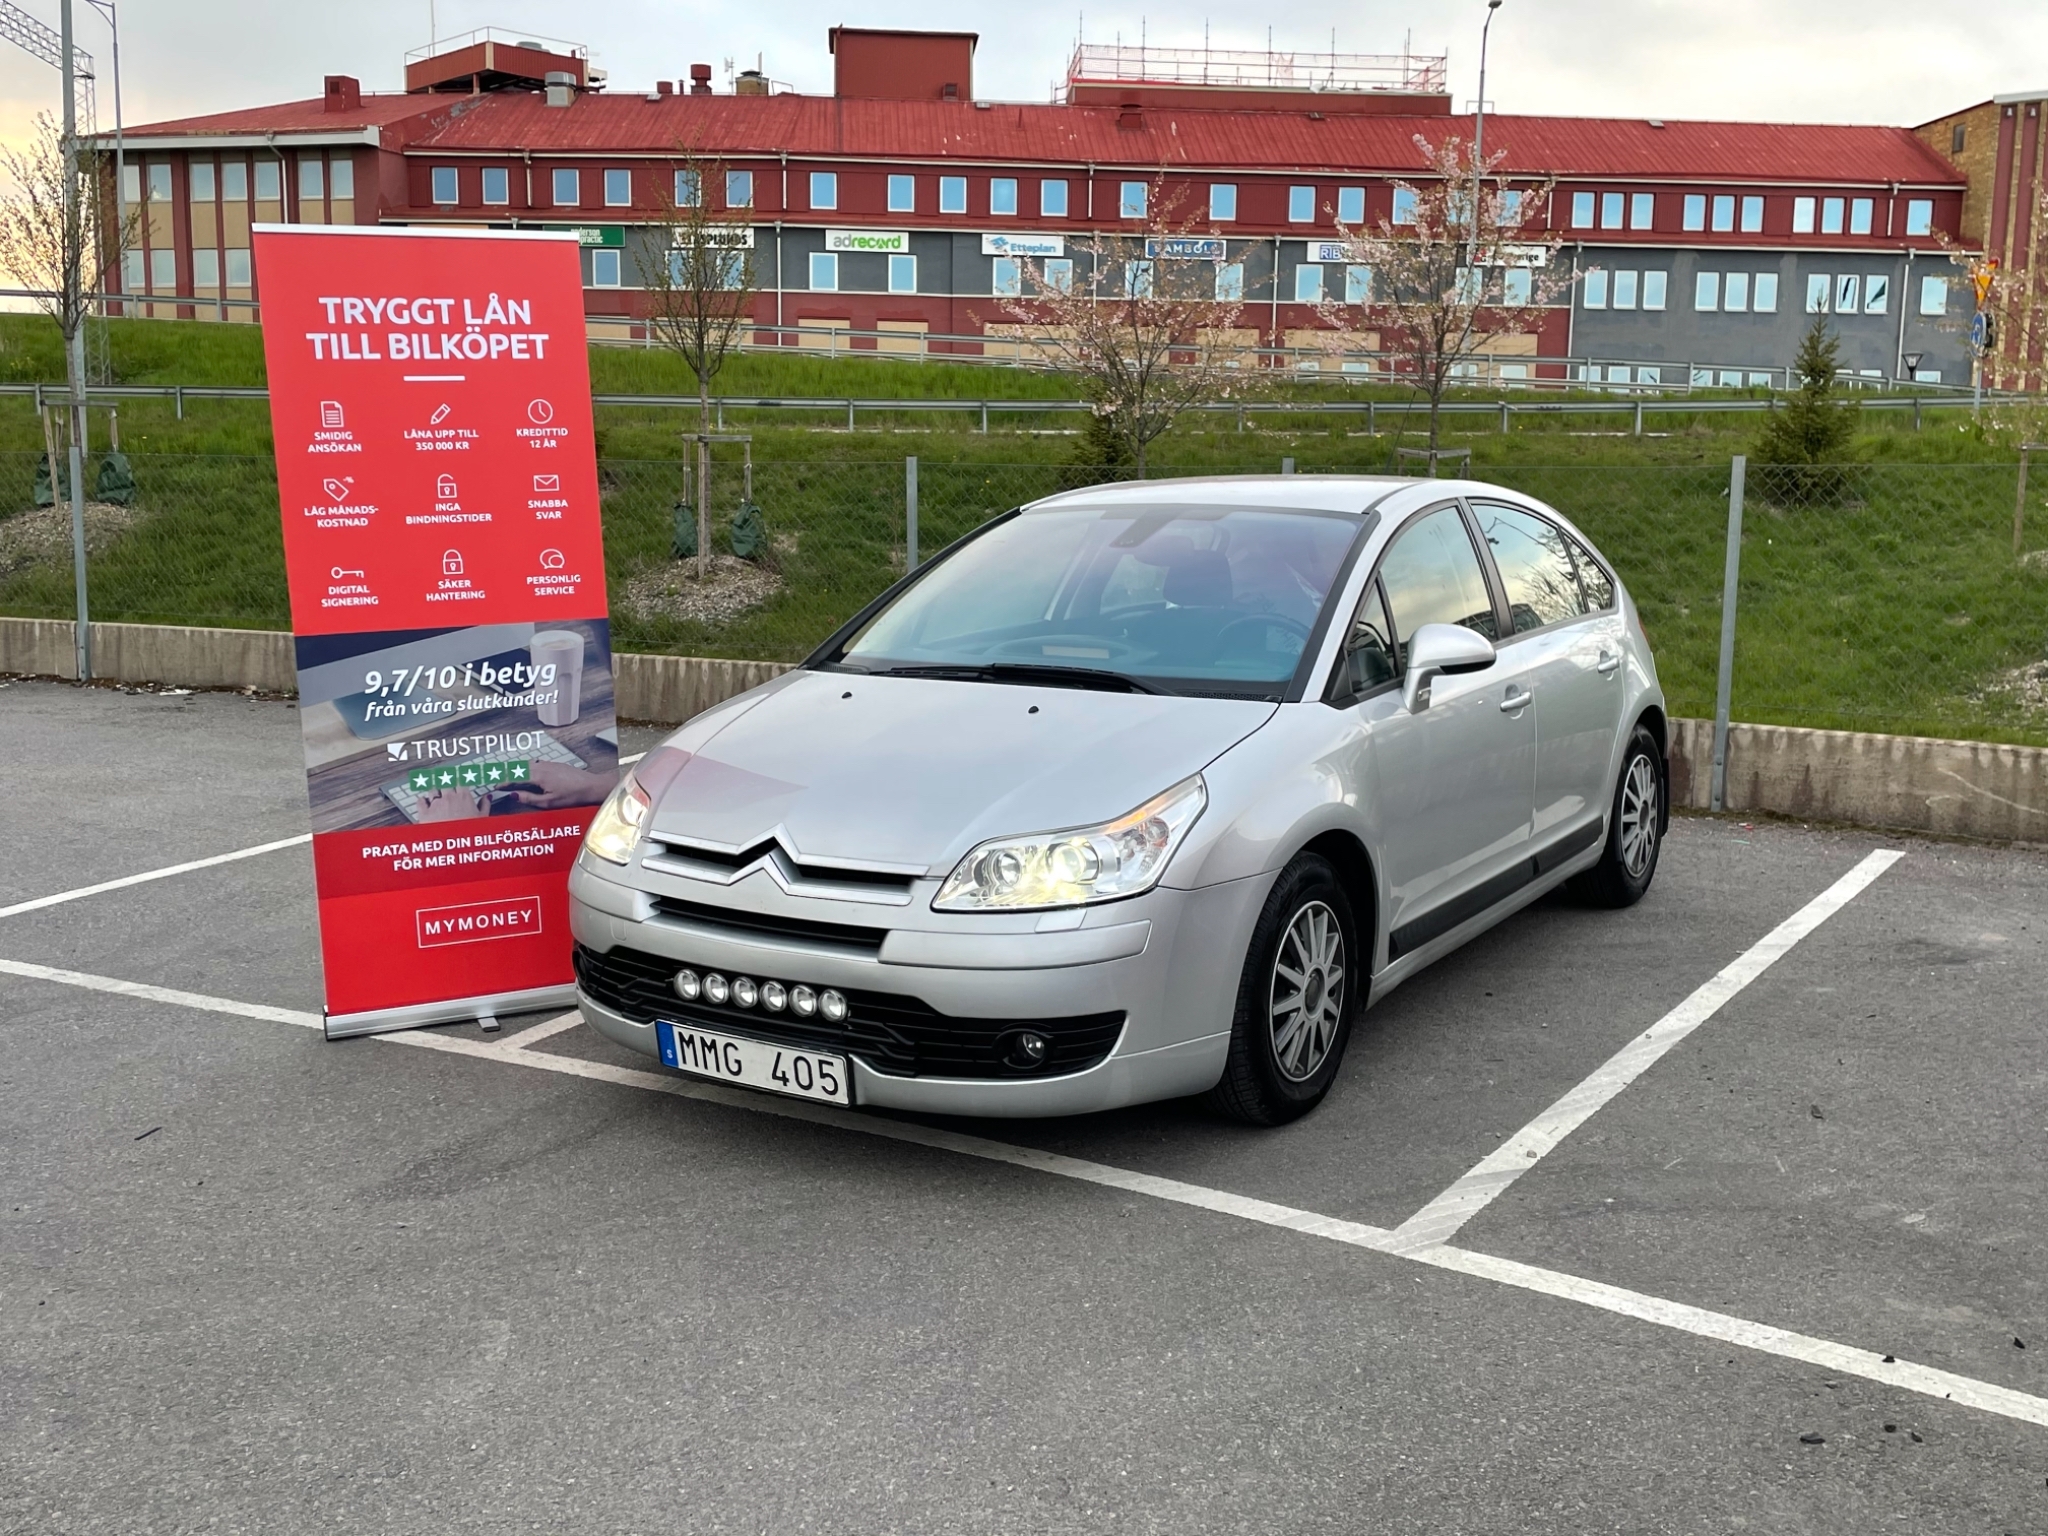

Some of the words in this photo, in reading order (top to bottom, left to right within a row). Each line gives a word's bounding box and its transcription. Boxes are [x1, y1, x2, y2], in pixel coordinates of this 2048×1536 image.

[834, 234, 901, 249] adrecord
[1010, 243, 1056, 253] Etteplan
[318, 298, 454, 324] TRYGGT
[464, 292, 530, 324] LÅN
[306, 332, 382, 360] TILL
[388, 326, 550, 360] BILKÖPET
[314, 431, 352, 441] SMIDIG
[404, 428, 434, 438] LÅNA
[434, 429, 456, 439] UPP
[456, 429, 478, 439] TILL
[516, 427, 568, 437] KREDITTID
[308, 442, 362, 452] ANSÖKAN
[416, 441, 434, 451] 350
[436, 441, 454, 451] 000
[456, 441, 470, 451] KR
[530, 439, 540, 449] 12
[544, 438, 556, 448] ÅR
[436, 502, 460, 512] INGA
[528, 499, 568, 509] SNABBA
[304, 506, 326, 516] LÅG
[328, 504, 378, 514] MÅNADS-
[536, 510, 562, 520] SVAR
[316, 518, 368, 528] KOSTNAD
[406, 514, 492, 524] BINDNINGSTIDER
[438, 578, 472, 590] SÄKER
[526, 574, 580, 584] PERSONLIG
[328, 584, 370, 594] DIGITAL
[534, 586, 574, 596] SERVICE
[426, 590, 486, 600] HANTERING
[322, 596, 378, 608] SIGNERING
[364, 665, 457, 698] 9,7/10
[463, 663, 475, 687] i
[478, 661, 557, 687] betyg
[364, 701, 406, 722] från
[411, 698, 452, 715] våra
[457, 690, 559, 712] slutkunder!
[412, 730, 545, 760] TRUSTPILOT
[362, 844, 410, 860] PRATA
[412, 840, 442, 852] MED
[446, 836, 470, 850] DIN
[474, 826, 580, 848] BILFÖRSÄLJARE
[394, 856, 422, 870] FÖR
[426, 854, 456, 868] MER
[458, 844, 554, 864] INFORMATION
[424, 908, 532, 936] MYMONEY
[667, 1049, 673, 1059] S
[678, 1031, 742, 1076] MMG
[772, 1052, 839, 1095] 405
